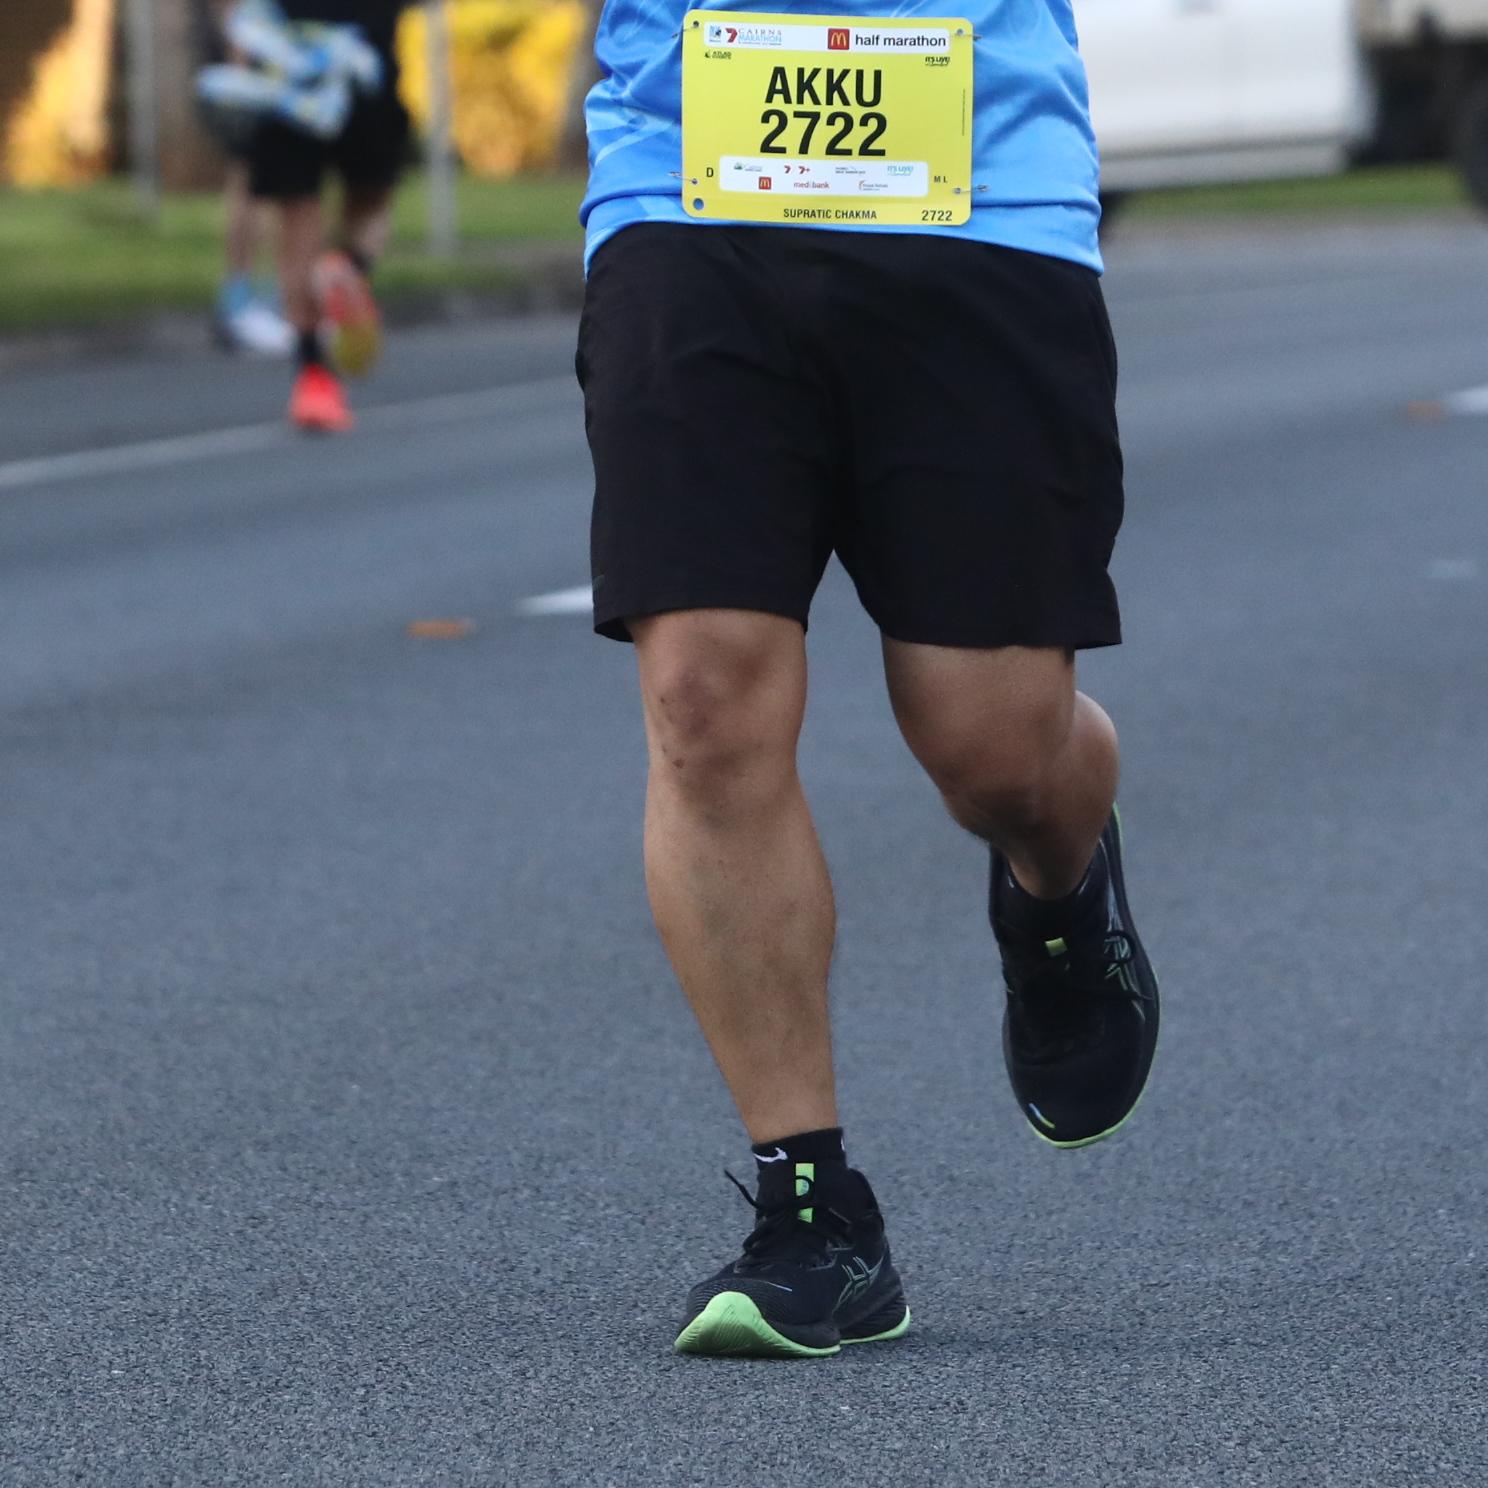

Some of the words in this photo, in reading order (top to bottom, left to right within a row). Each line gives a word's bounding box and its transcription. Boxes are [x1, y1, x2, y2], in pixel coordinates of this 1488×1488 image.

[855, 34, 880, 46] half
[883, 35, 946, 47] marathon
[765, 66, 882, 108] AKKU
[760, 109, 888, 156] 2722
[706, 167, 714, 178] D
[783, 207, 832, 219] SUPRATIC
[834, 209, 877, 220] CHAKMA
[921, 209, 953, 222] 2722
